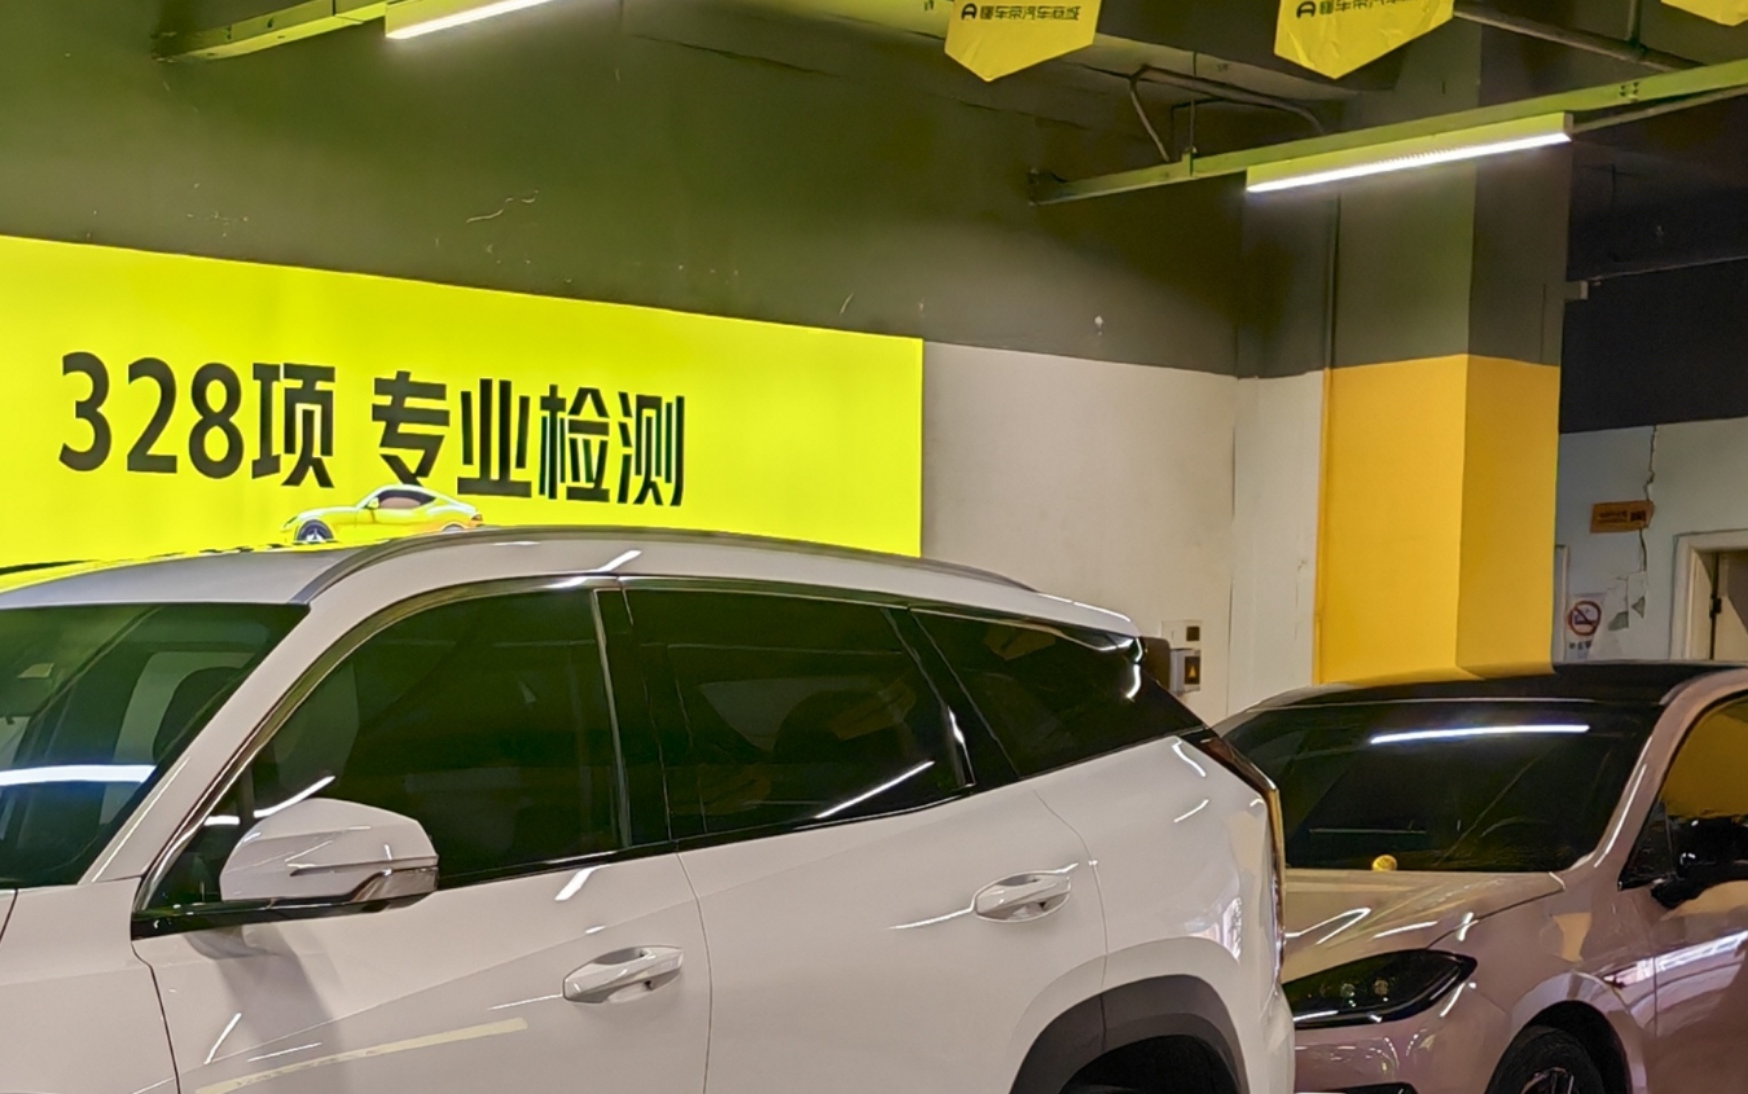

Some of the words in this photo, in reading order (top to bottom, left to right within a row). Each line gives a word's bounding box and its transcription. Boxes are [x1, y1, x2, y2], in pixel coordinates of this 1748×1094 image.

[58, 351, 336, 488] 328项
[371, 371, 686, 507] 专业检测
